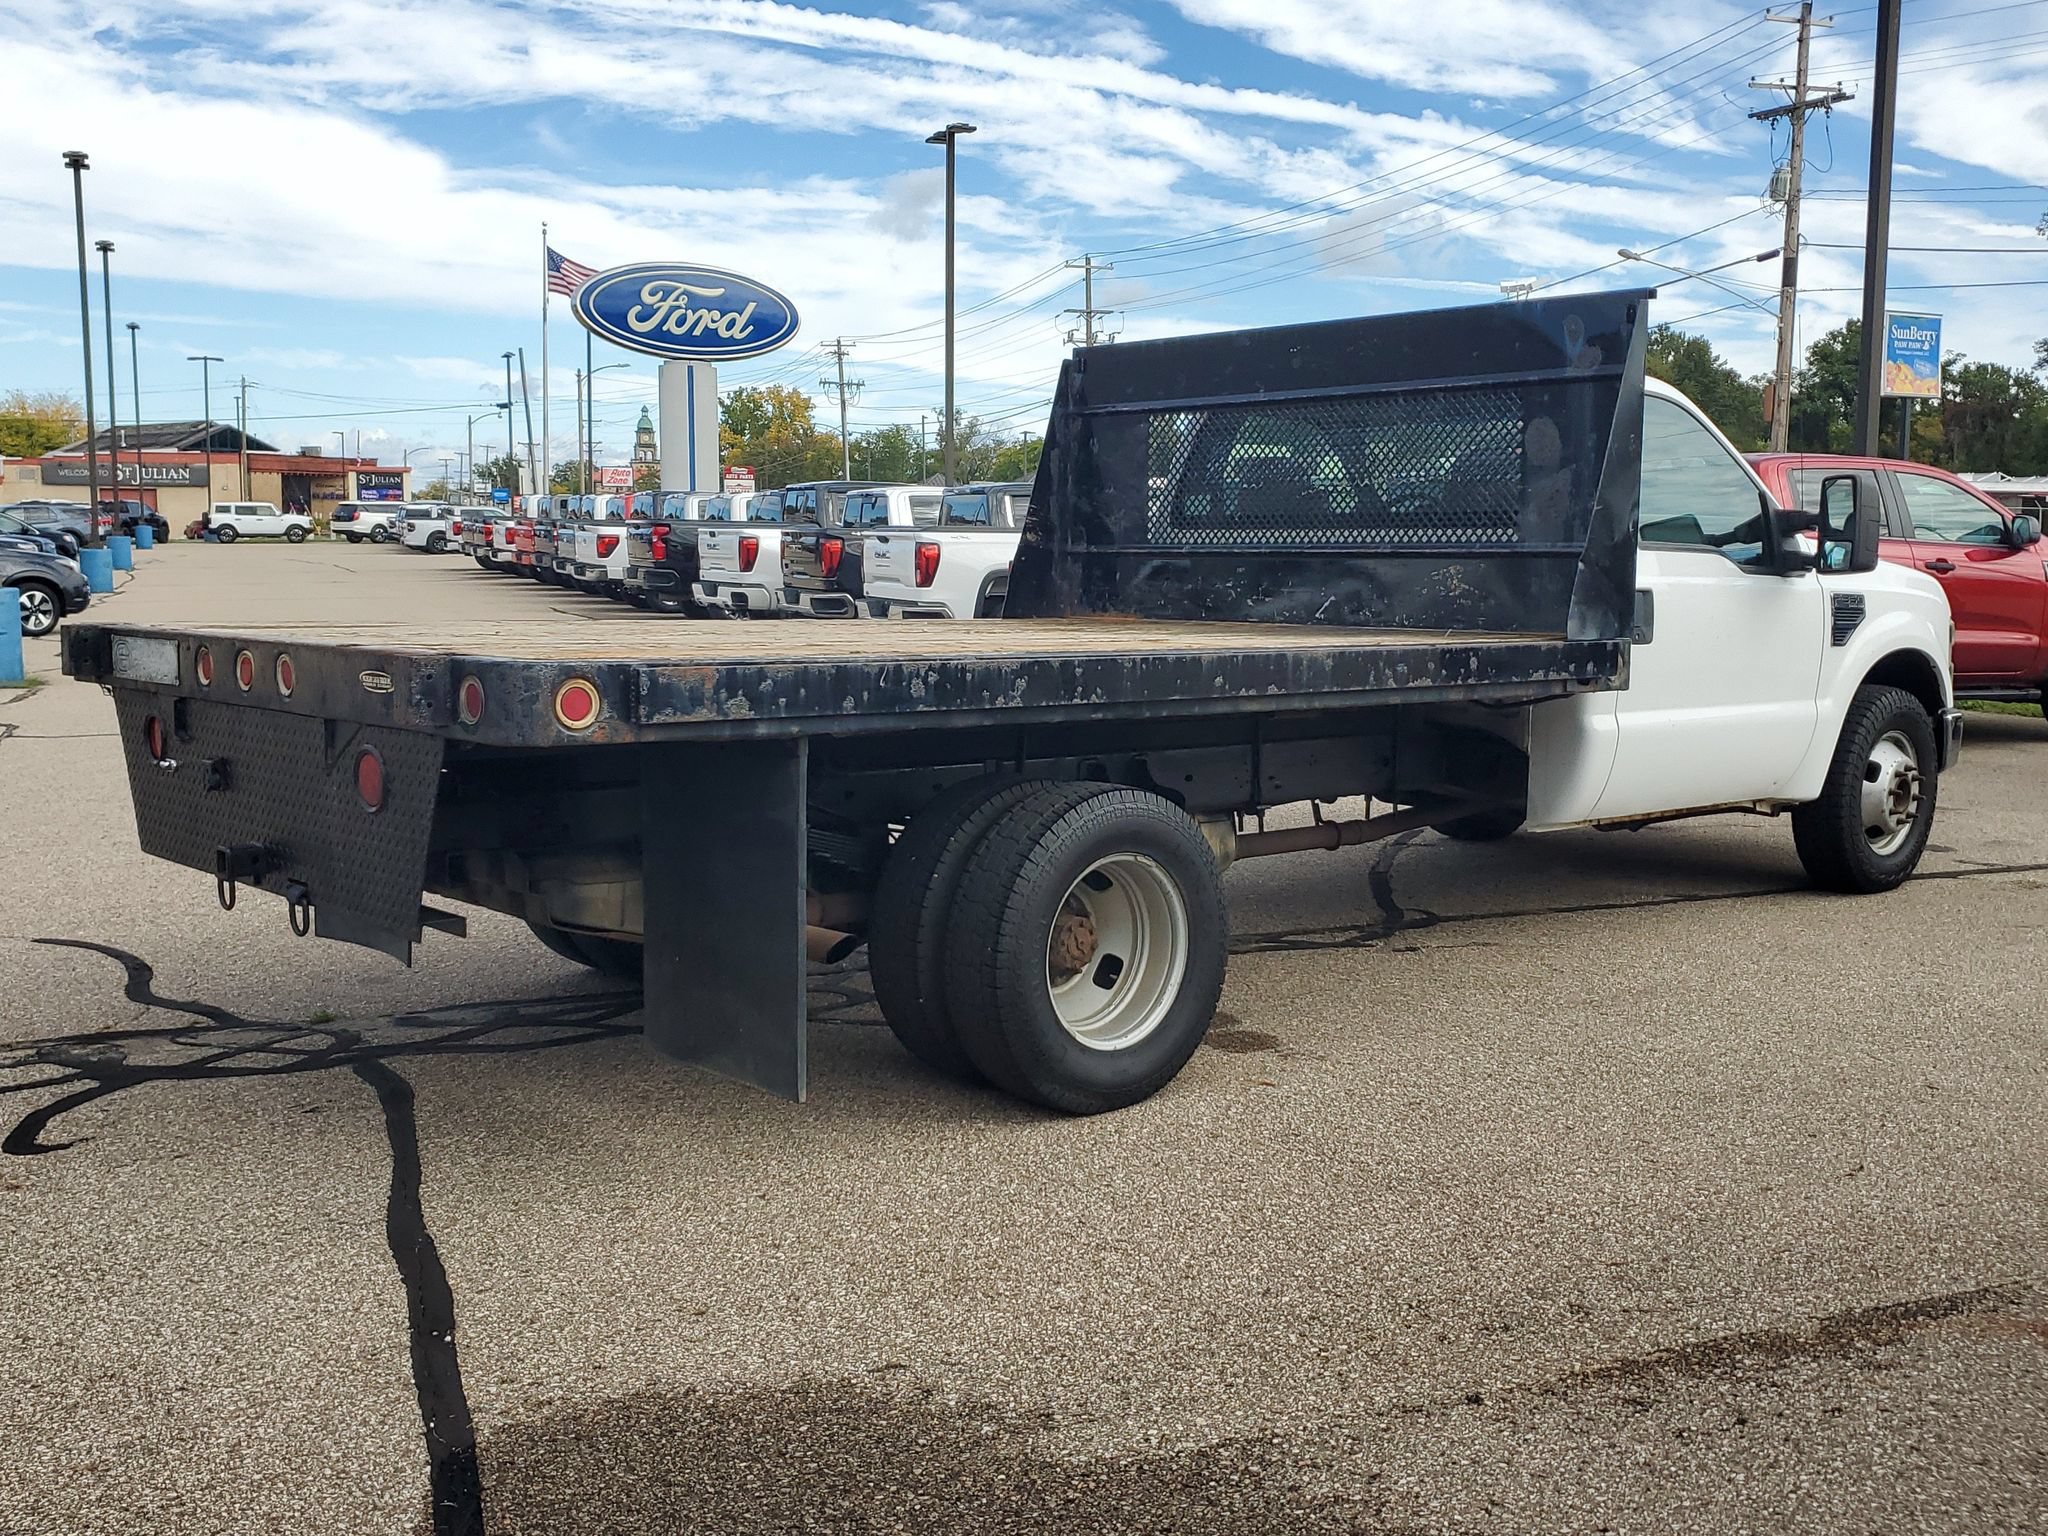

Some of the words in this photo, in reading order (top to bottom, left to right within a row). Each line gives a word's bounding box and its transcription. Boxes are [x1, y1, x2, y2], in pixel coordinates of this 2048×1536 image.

[627, 280, 757, 340] Ford
[1890, 324, 1938, 345] SunBerry
[98, 469, 109, 477] TO
[131, 464, 190, 485] JULIAN
[370, 474, 401, 486] JULIAN
[607, 476, 628, 484] Zone
[610, 469, 631, 477] Auto
